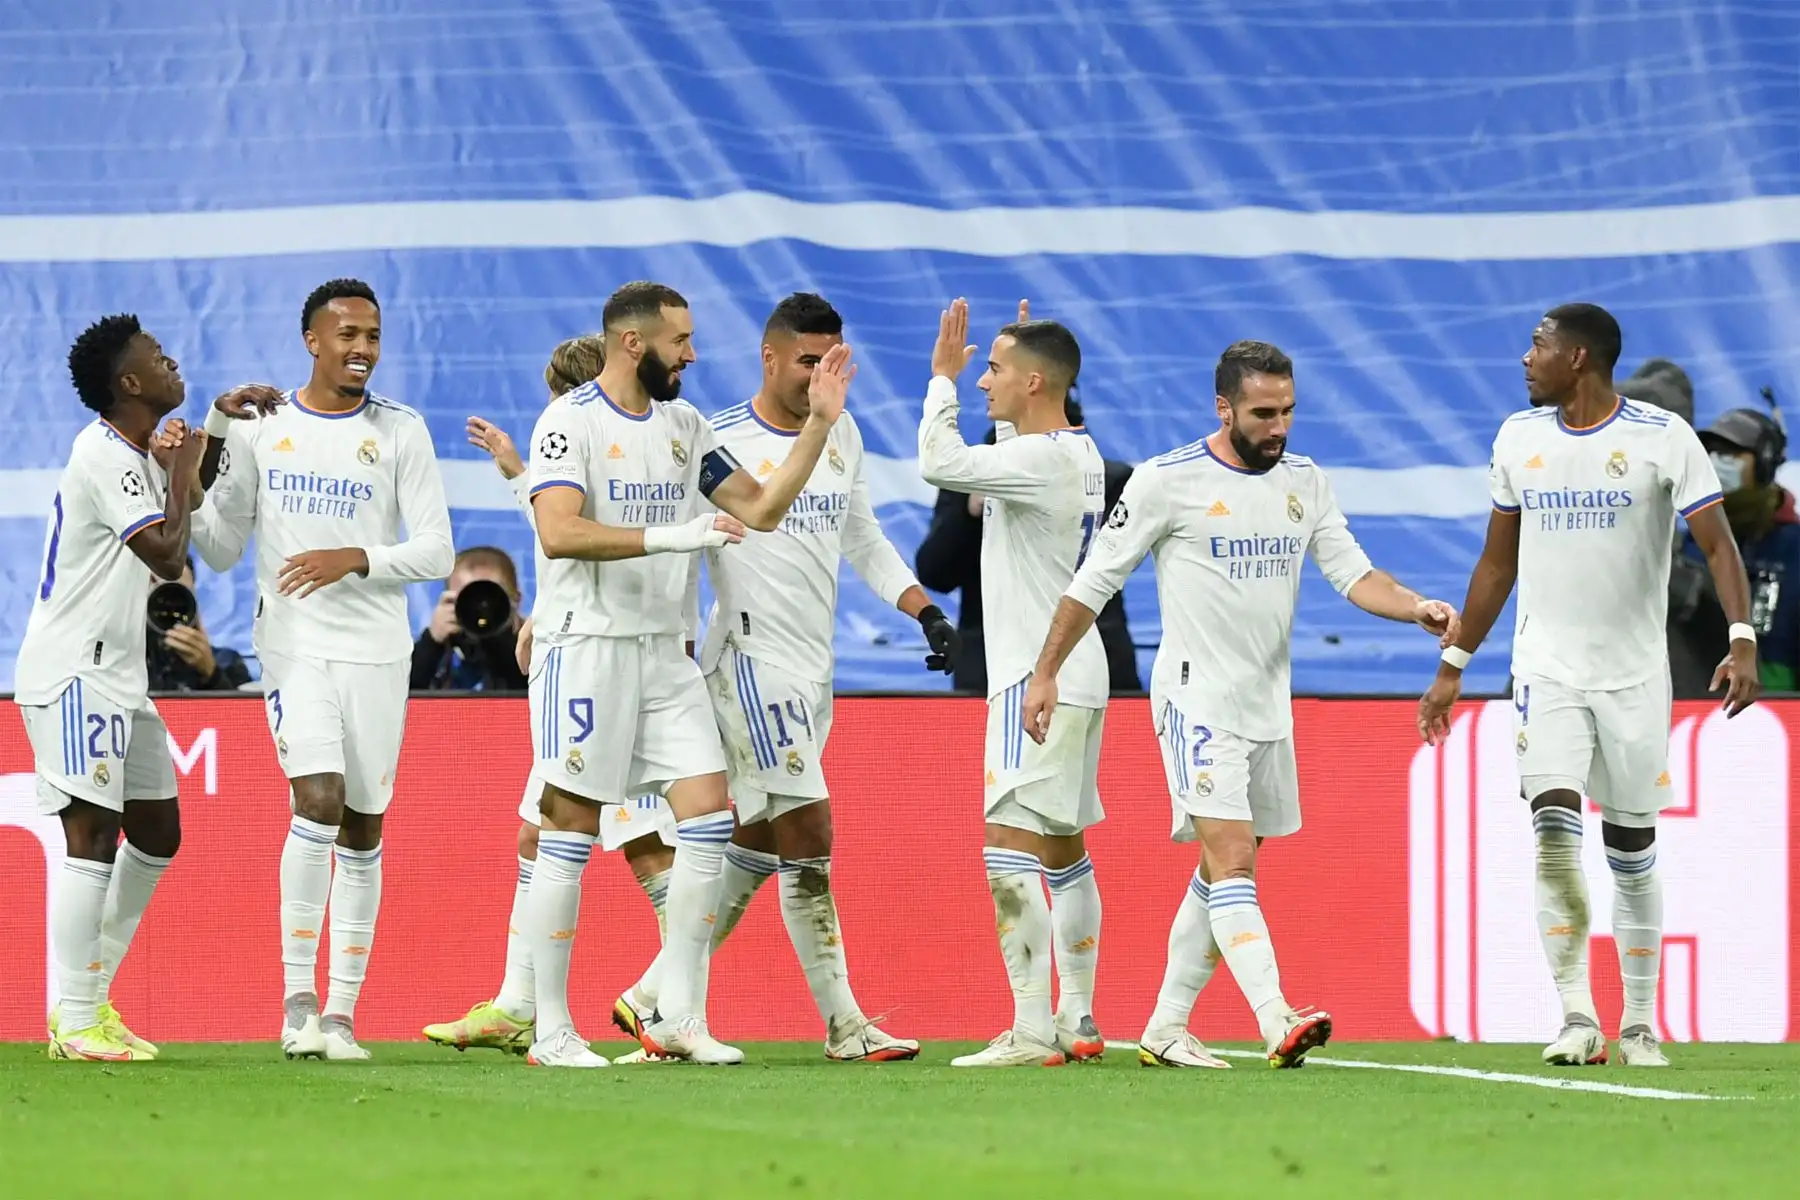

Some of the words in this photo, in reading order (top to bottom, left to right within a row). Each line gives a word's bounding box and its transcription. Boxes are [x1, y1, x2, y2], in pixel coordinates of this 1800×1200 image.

[268, 469, 373, 501] Emirates
[608, 479, 685, 501] Emrates
[1523, 486, 1632, 510] Emirates
[282, 494, 303, 512] FLY
[307, 496, 356, 520] BETTER
[622, 505, 641, 523] FLY
[1541, 512, 1561, 531] FLY
[1566, 512, 1616, 530] BETTER
[1229, 561, 1251, 579] FLY
[267, 688, 283, 734] 3
[569, 698, 594, 743] 9
[767, 697, 813, 748] 14
[87, 713, 126, 759] 20
[1192, 725, 1213, 767] 2
